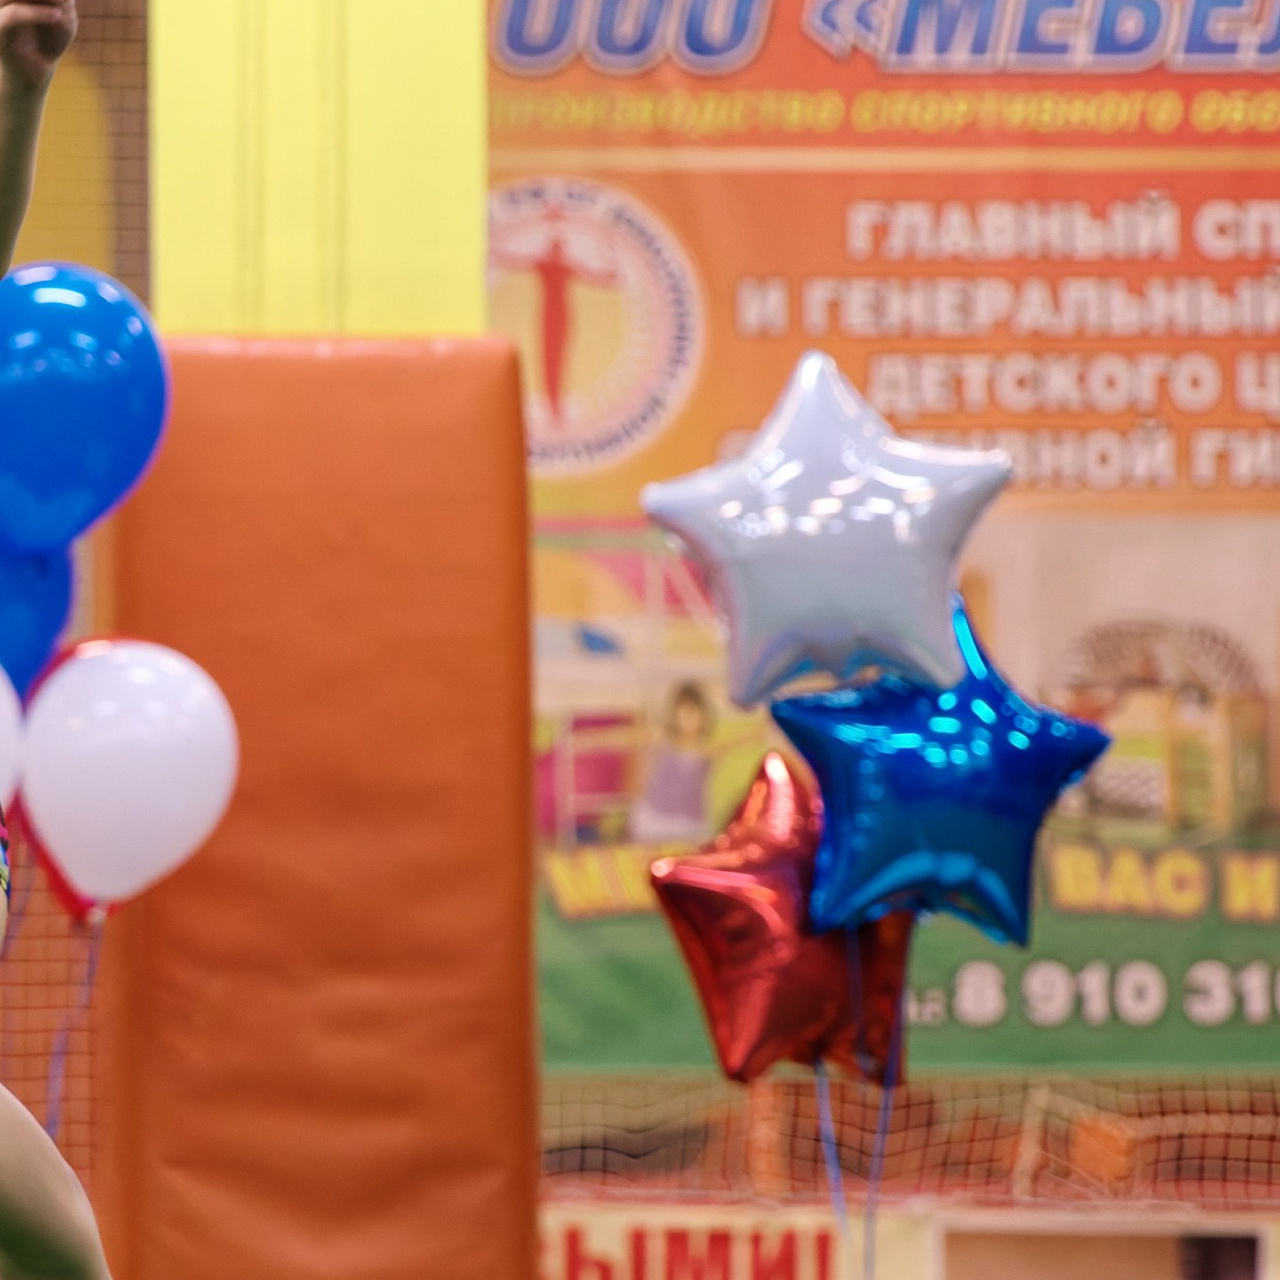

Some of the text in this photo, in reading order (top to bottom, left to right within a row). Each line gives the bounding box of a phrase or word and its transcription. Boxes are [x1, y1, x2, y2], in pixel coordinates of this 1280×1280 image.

[846, 190, 1182, 261] ГЛАВНЫЙ
[868, 352, 1220, 418] ДЕТСКОГО
[1020, 959, 1168, 1027] 910
